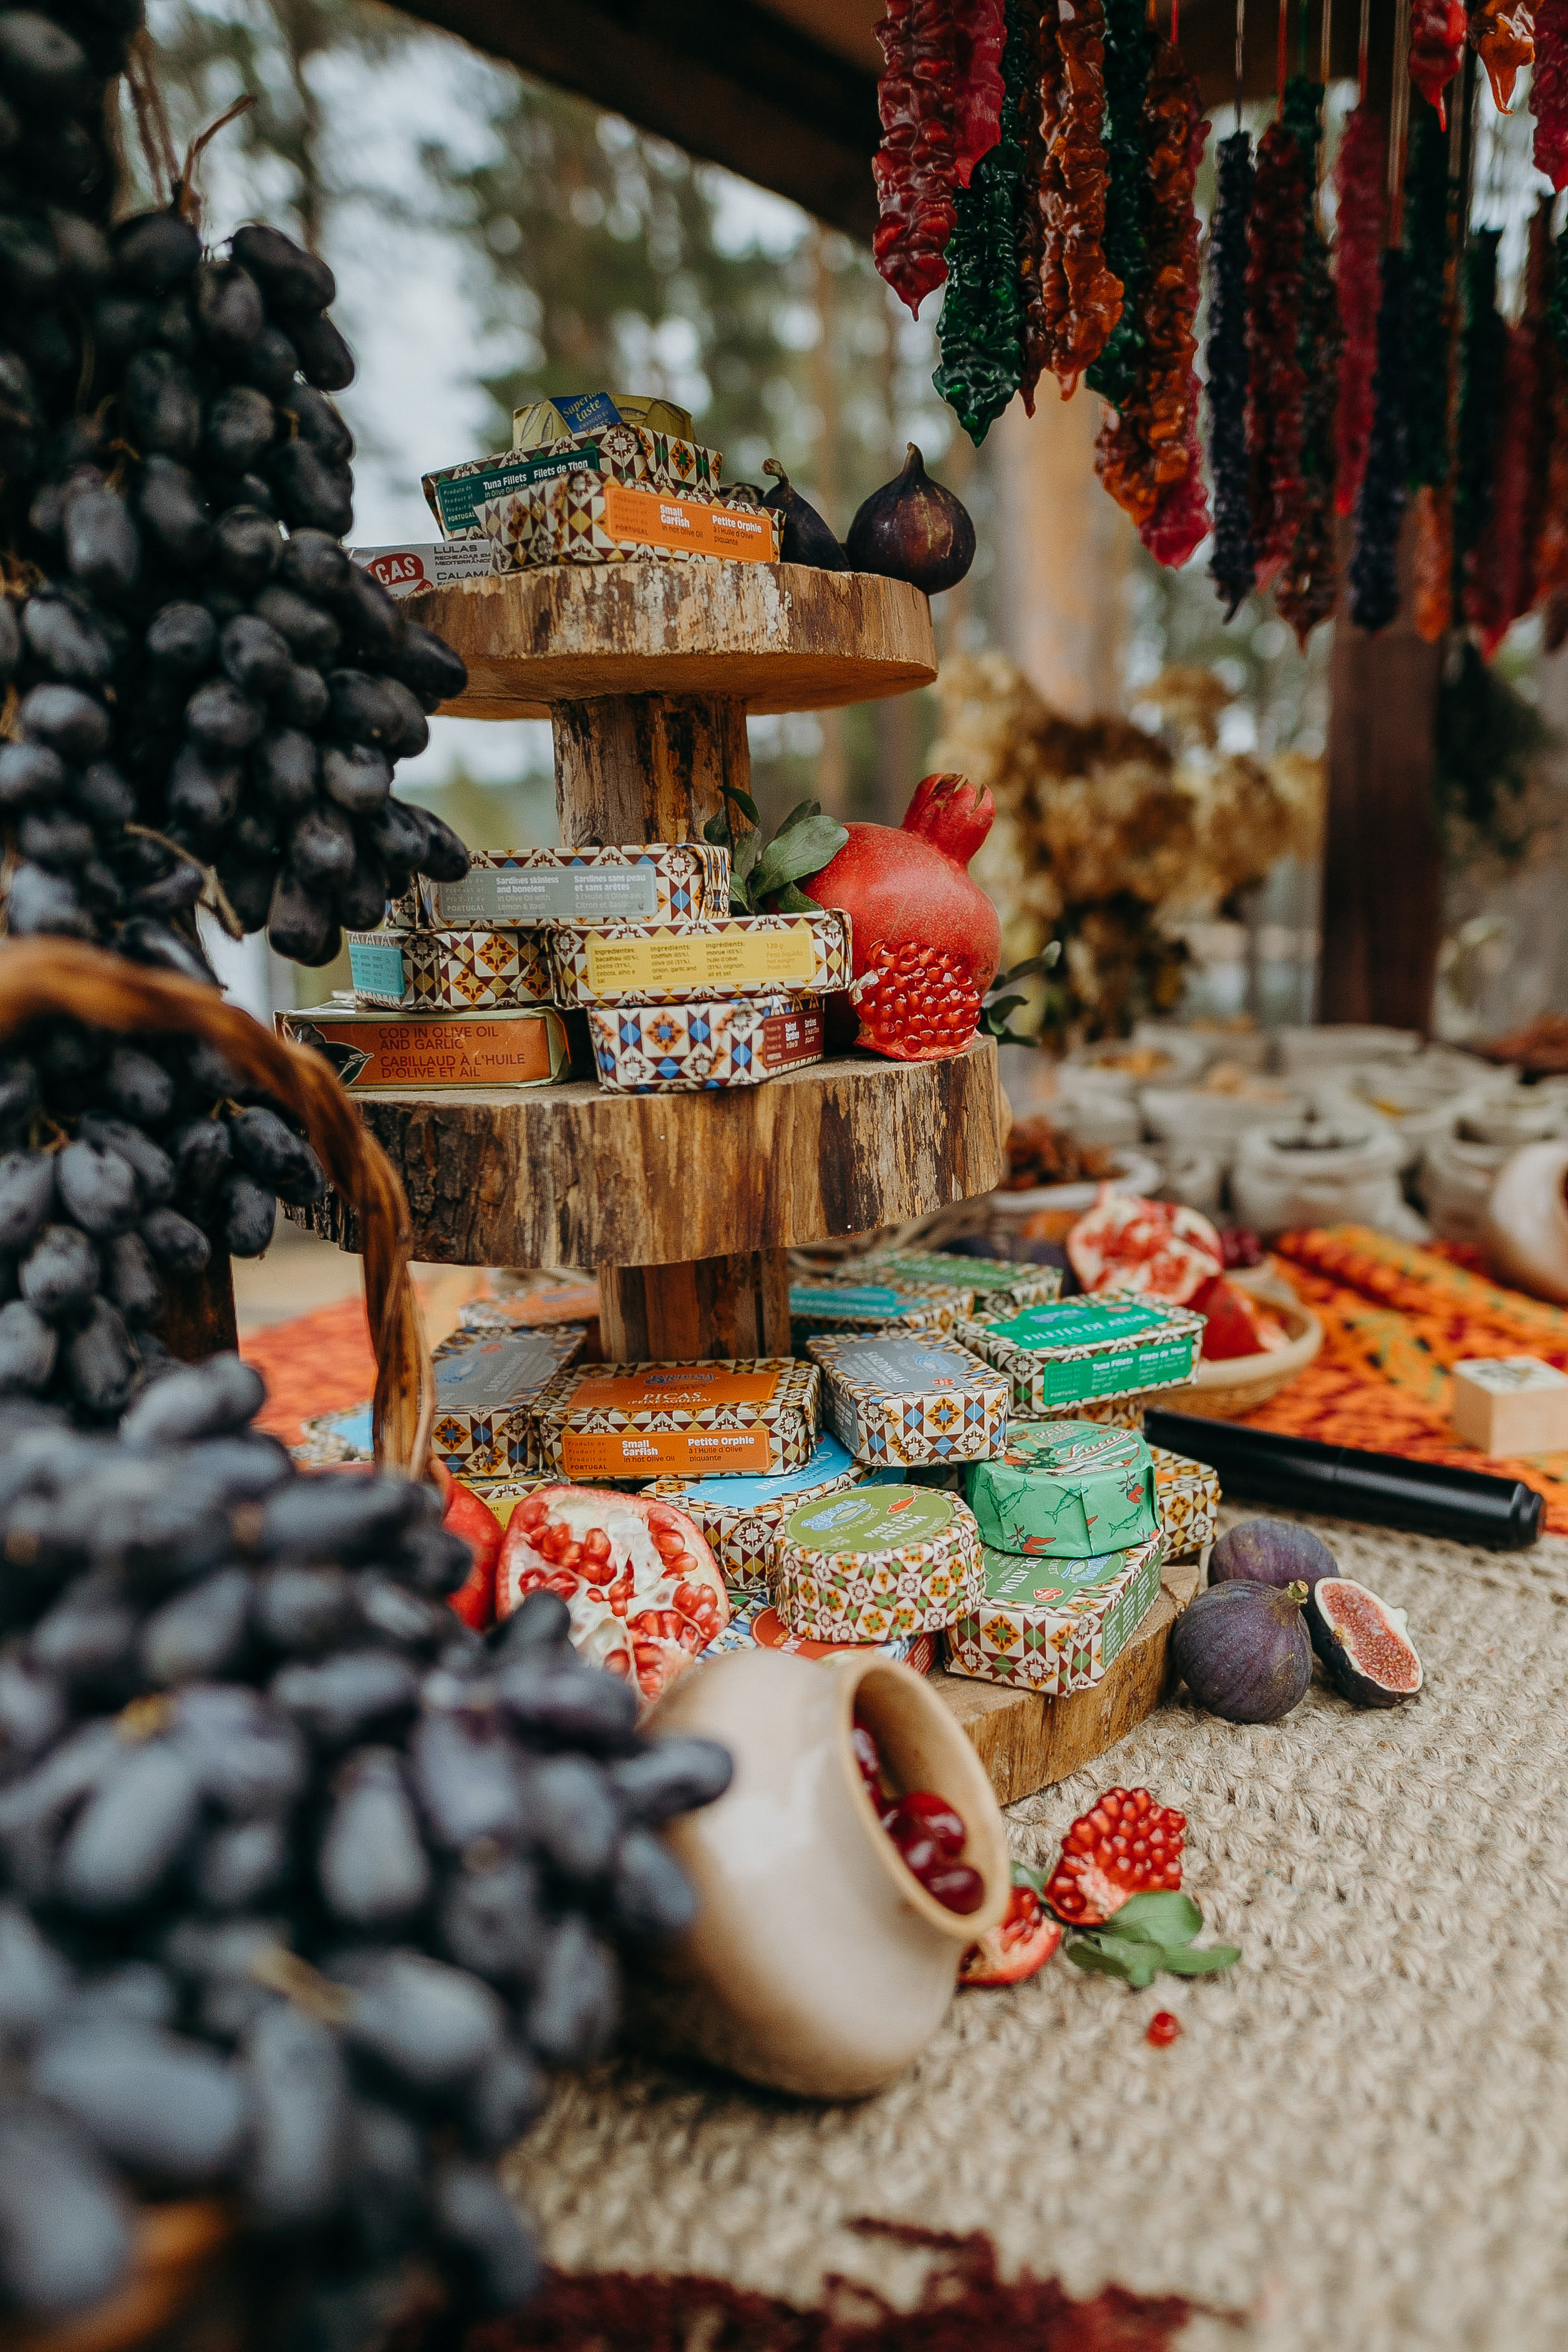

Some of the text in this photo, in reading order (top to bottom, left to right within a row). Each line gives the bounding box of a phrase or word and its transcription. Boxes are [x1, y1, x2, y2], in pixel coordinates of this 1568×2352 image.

[576, 399, 601, 422] taste
[533, 460, 588, 479] Filets de Thon
[483, 480, 502, 490] Tuna
[503, 473, 527, 486] Fillets
[491, 488, 505, 497] Olive
[444, 496, 466, 504] Product
[447, 511, 475, 522] PORTUGAL
[660, 504, 683, 518] Small
[661, 515, 690, 528] Garfish
[712, 515, 762, 533] Petite Orphie
[669, 526, 680, 535] hot
[680, 528, 695, 537] Olive
[695, 530, 704, 539] Oil
[714, 536, 739, 546] piquante
[433, 544, 478, 554] LULAS
[496, 876, 559, 885] Sardines skinless
[574, 874, 646, 884] Sardines sans peau
[496, 884, 545, 894] and boneless
[575, 884, 584, 892] et
[585, 883, 603, 892] sans
[379, 1026, 499, 1039] COD IN OLIVE OIL
[379, 1038, 464, 1050] AND GARLIC
[380, 1052, 525, 1067] CABILLAUD À L'HUILE
[382, 1066, 480, 1078] D'OLIVE ET AIL
[1093, 1362, 1110, 1371] Tuna
[643, 1391, 702, 1400] PICAS
[622, 1440, 650, 1449] Small
[687, 1436, 755, 1446] Petite Orphie
[622, 1448, 659, 1456] Garfish
[689, 1454, 722, 1463] piquante
[830, 1508, 880, 1532] GOURMET
[891, 1512, 912, 1522] DE
[879, 1516, 929, 1541] ATUM
[1020, 1557, 1043, 1569] DE
[1048, 1559, 1061, 1575] RMET
[996, 1569, 1030, 1594] ATUM
